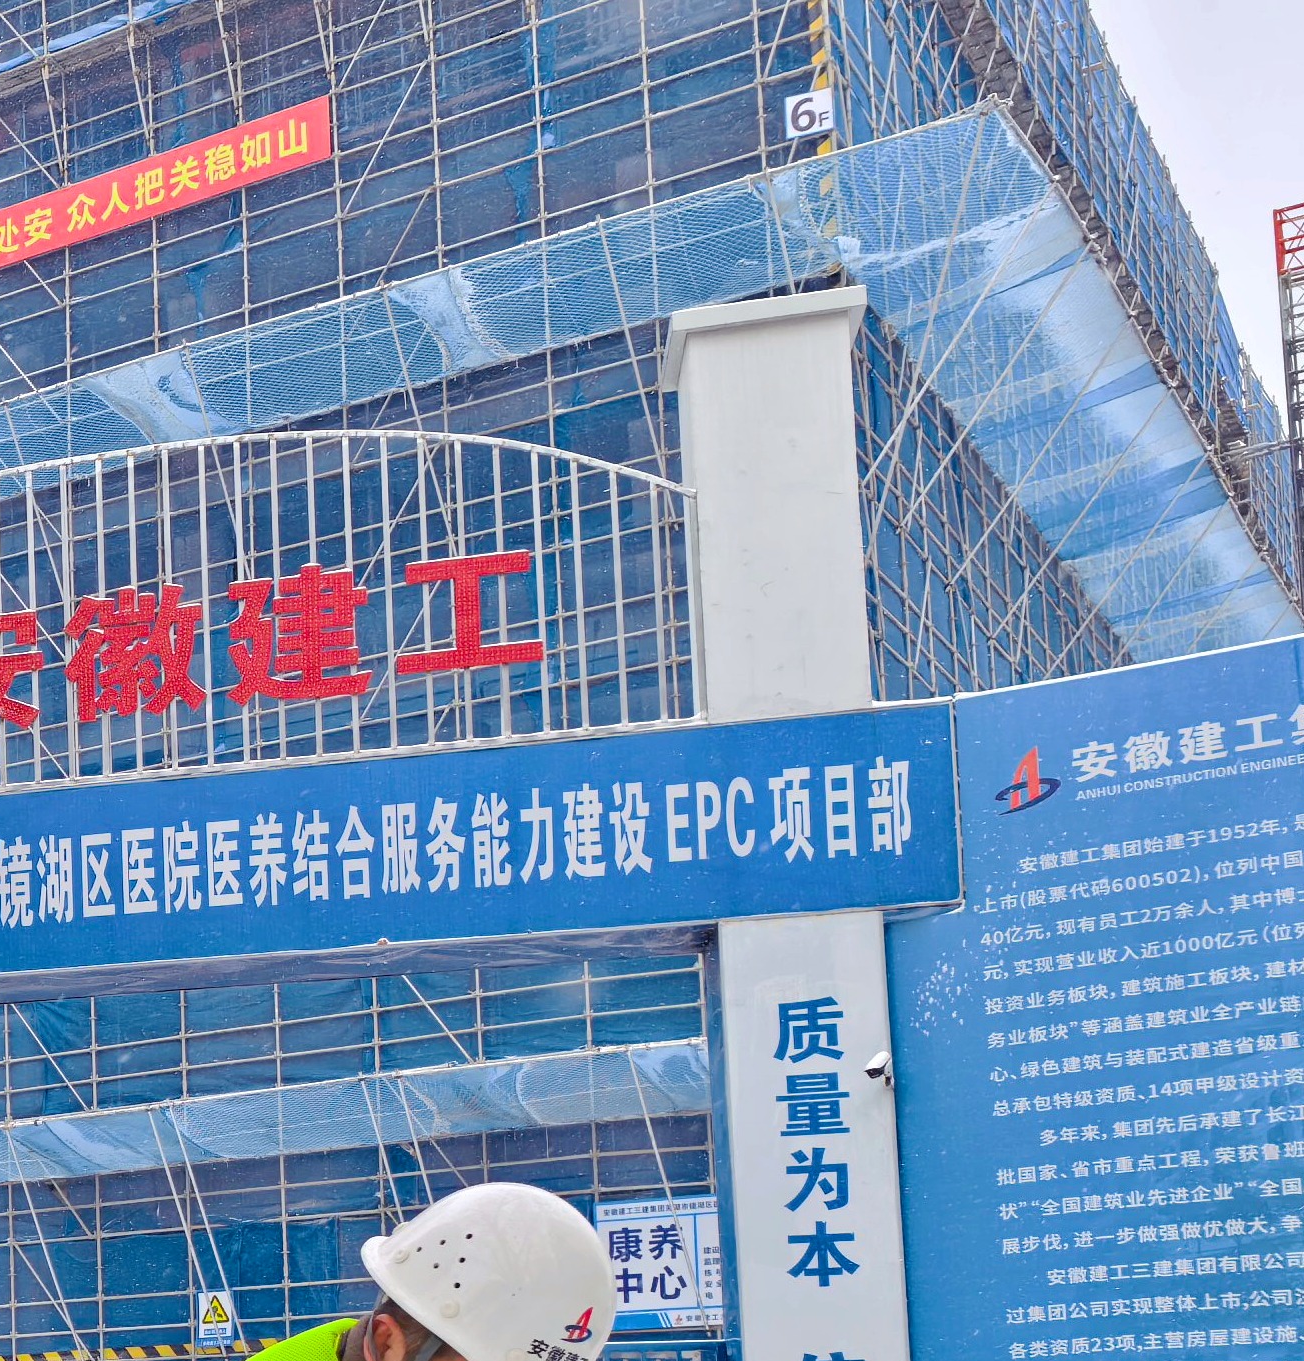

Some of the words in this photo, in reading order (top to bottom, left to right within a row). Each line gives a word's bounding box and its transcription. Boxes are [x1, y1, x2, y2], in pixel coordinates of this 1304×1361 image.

[791, 97, 829, 132] 6F
[66, 115, 311, 233] 众人把关稳如山
[1075, 784, 1121, 801] ANHUI
[1124, 765, 1237, 793] CONSTRUCTION
[980, 887, 1304, 947] 40亿元，现有员工2万余人，其中博
[772, 995, 860, 1288] 质量为本
[609, 1223, 684, 1262] 康养
[615, 1265, 687, 1303] 中心
[1047, 1251, 1304, 1286] 安徽建工三建集团有限公司
